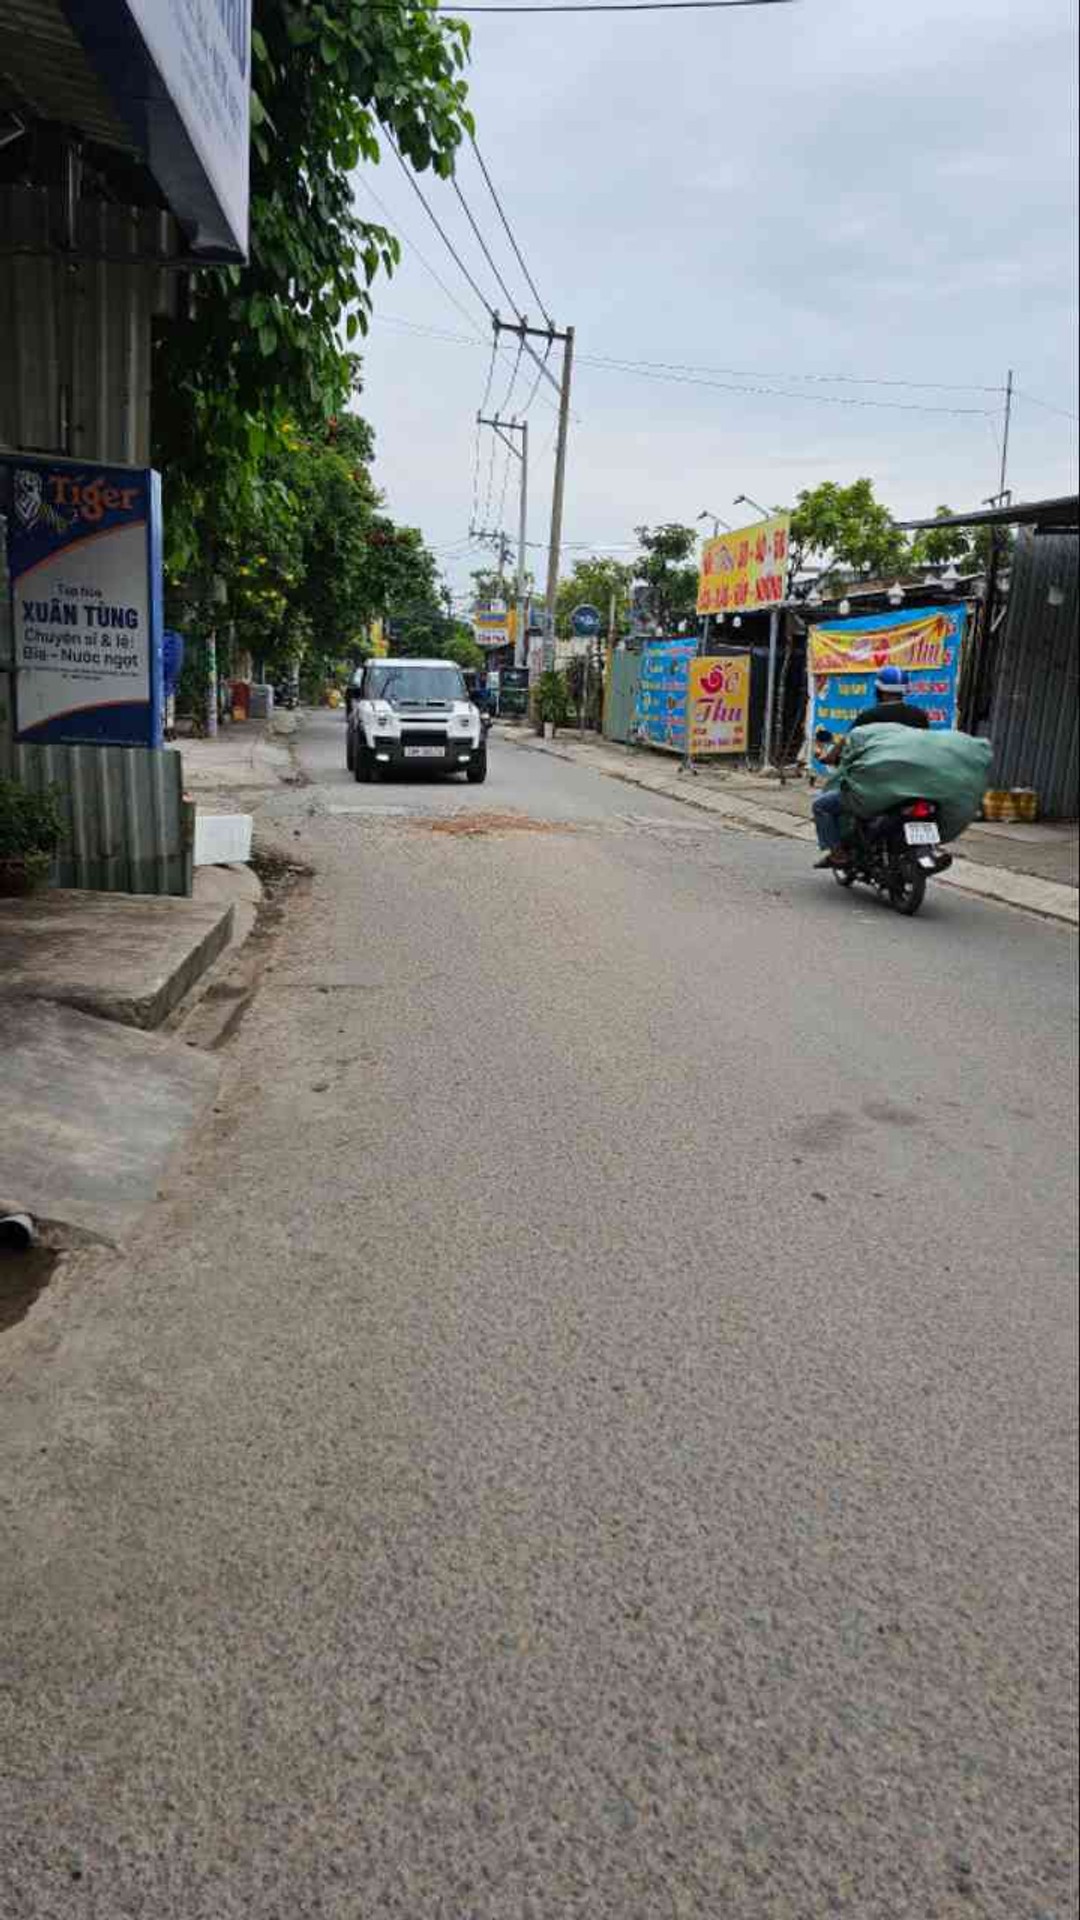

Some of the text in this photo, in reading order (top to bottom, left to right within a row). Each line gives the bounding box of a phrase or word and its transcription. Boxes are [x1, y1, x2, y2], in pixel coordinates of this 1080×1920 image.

[48, 475, 138, 520] Tiger
[22, 598, 77, 625] XUÂN
[101, 635, 112, 648] &
[695, 697, 743, 722] Thu
